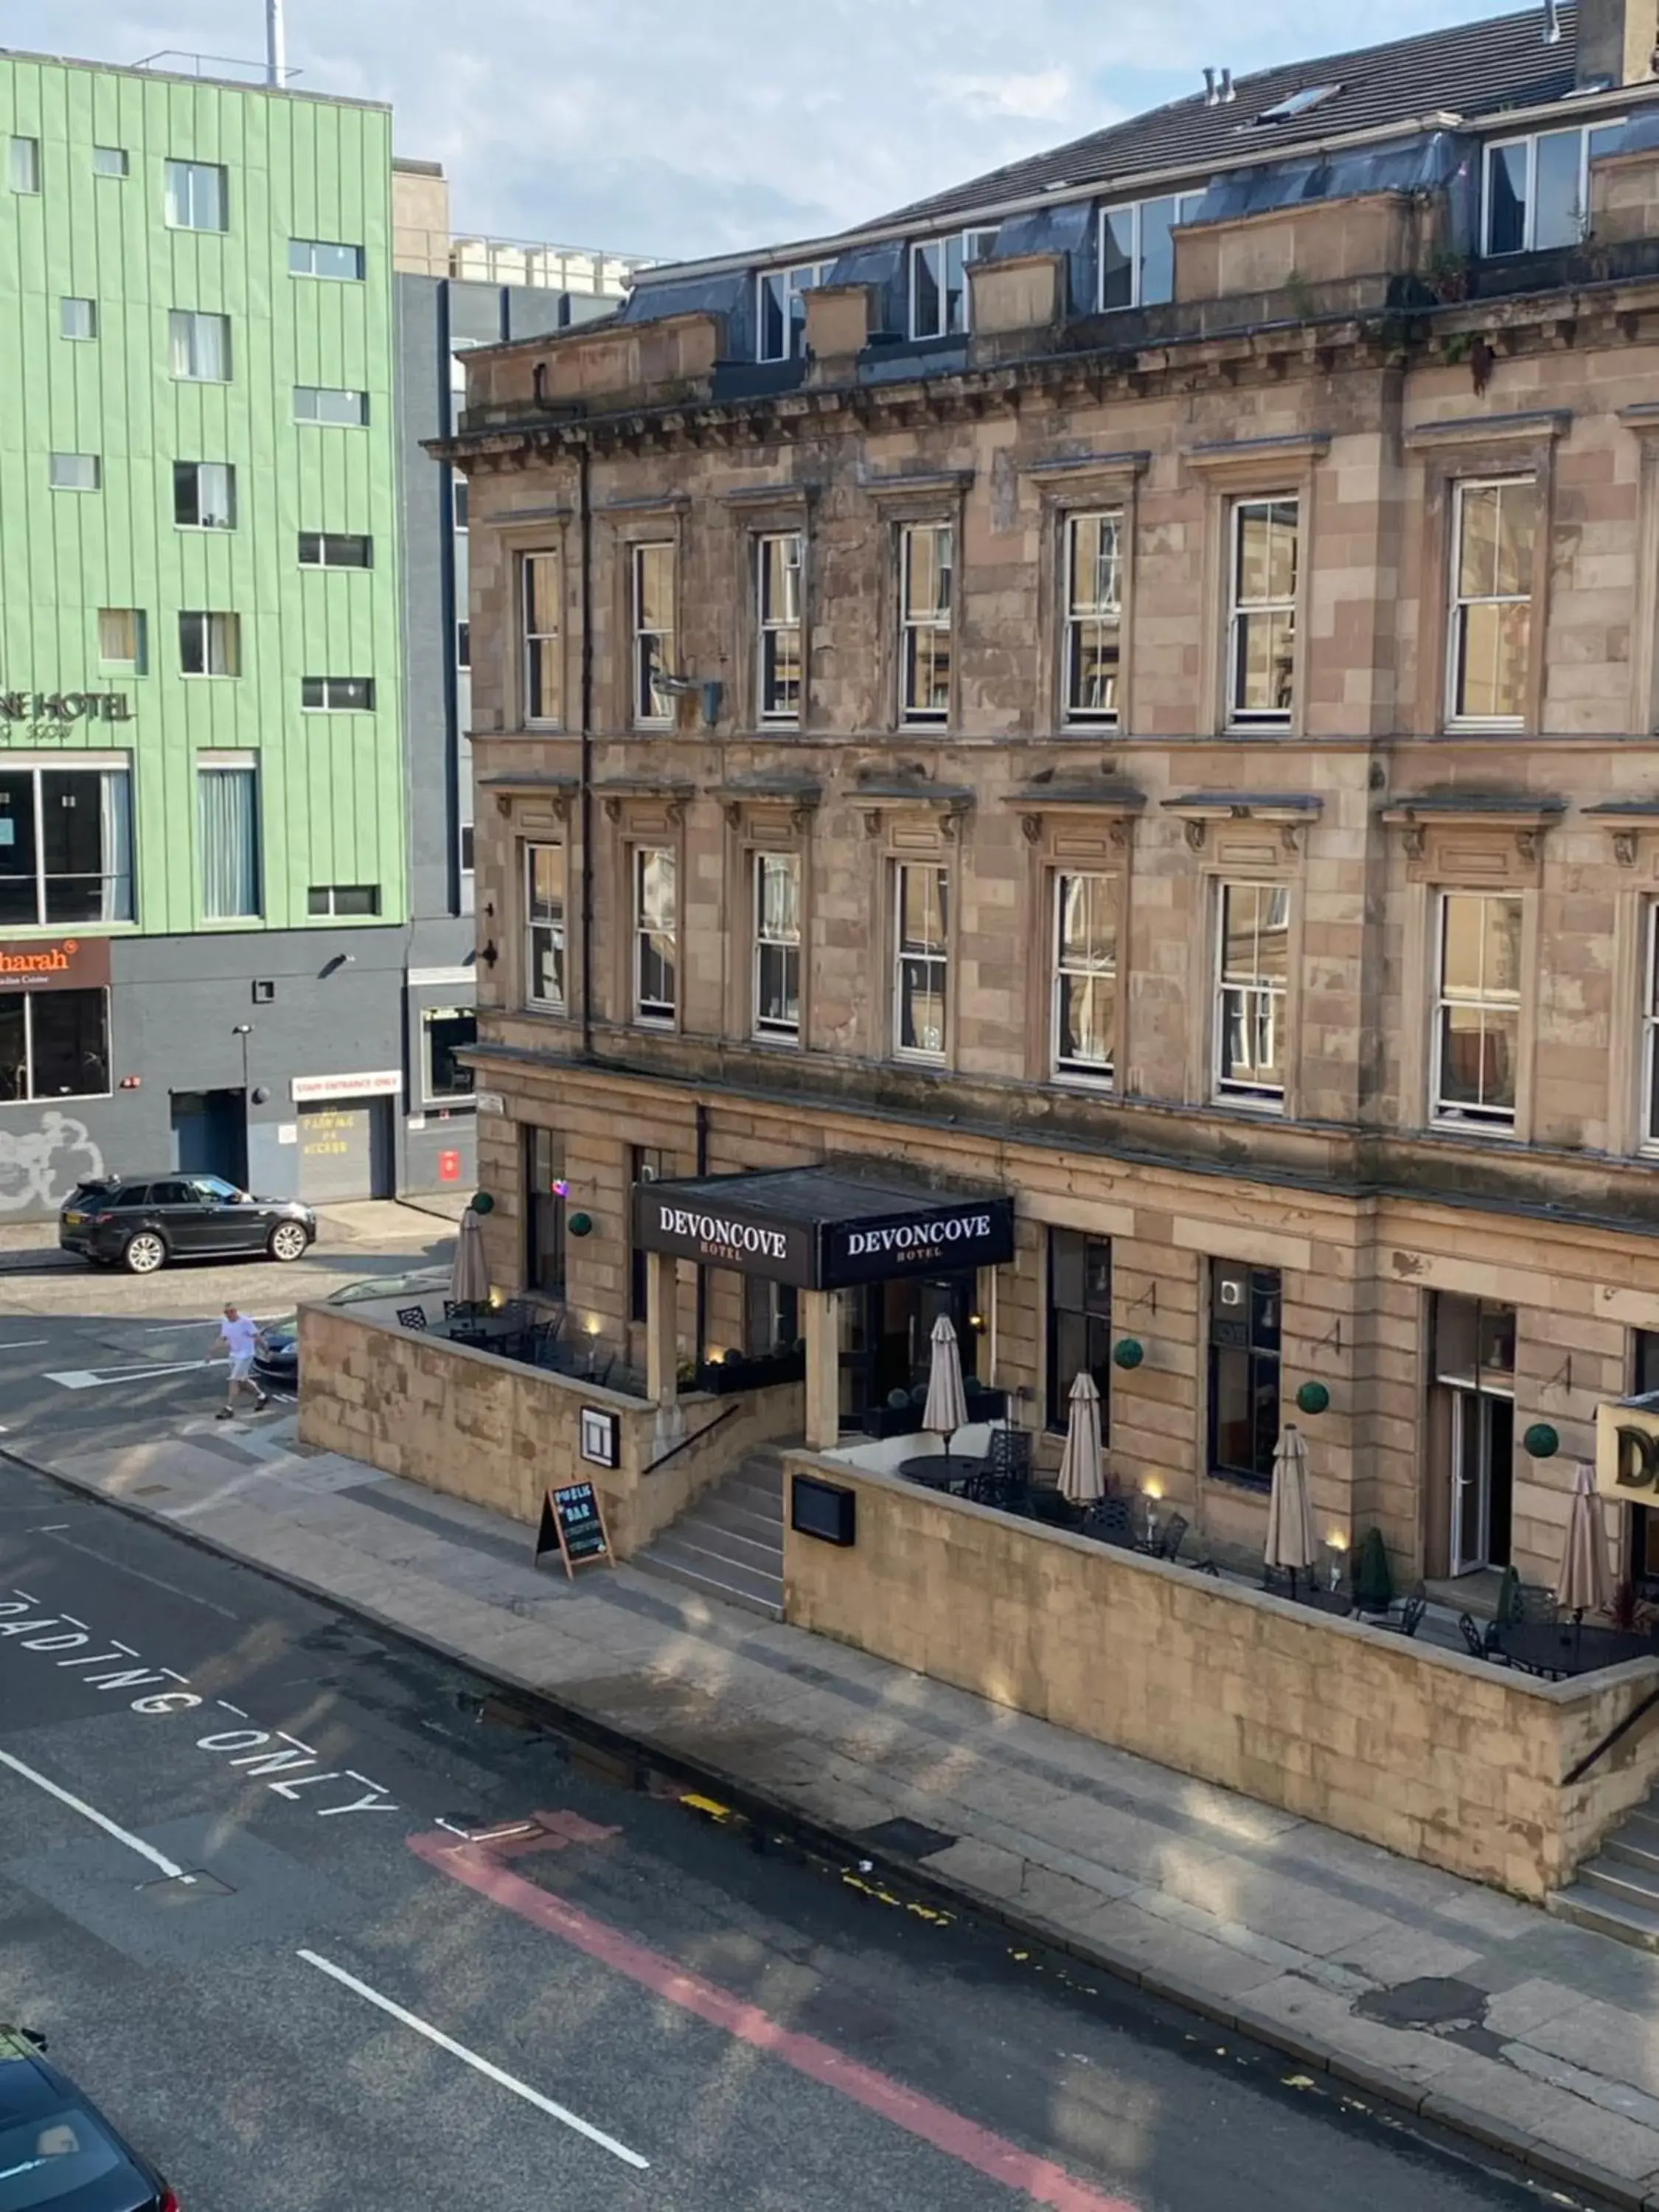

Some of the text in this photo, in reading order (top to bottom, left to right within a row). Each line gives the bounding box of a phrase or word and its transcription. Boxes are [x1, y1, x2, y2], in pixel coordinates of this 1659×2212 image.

[33, 692, 139, 723] HOTEL
[660, 1206, 787, 1259] DEVONCOVE
[700, 1241, 742, 1262] HOTEL
[848, 1215, 991, 1255] DEVONCOVE
[897, 1247, 942, 1263] HOTEL
[1615, 1425, 1659, 1494] D
[195, 1729, 400, 1816] ONLY
